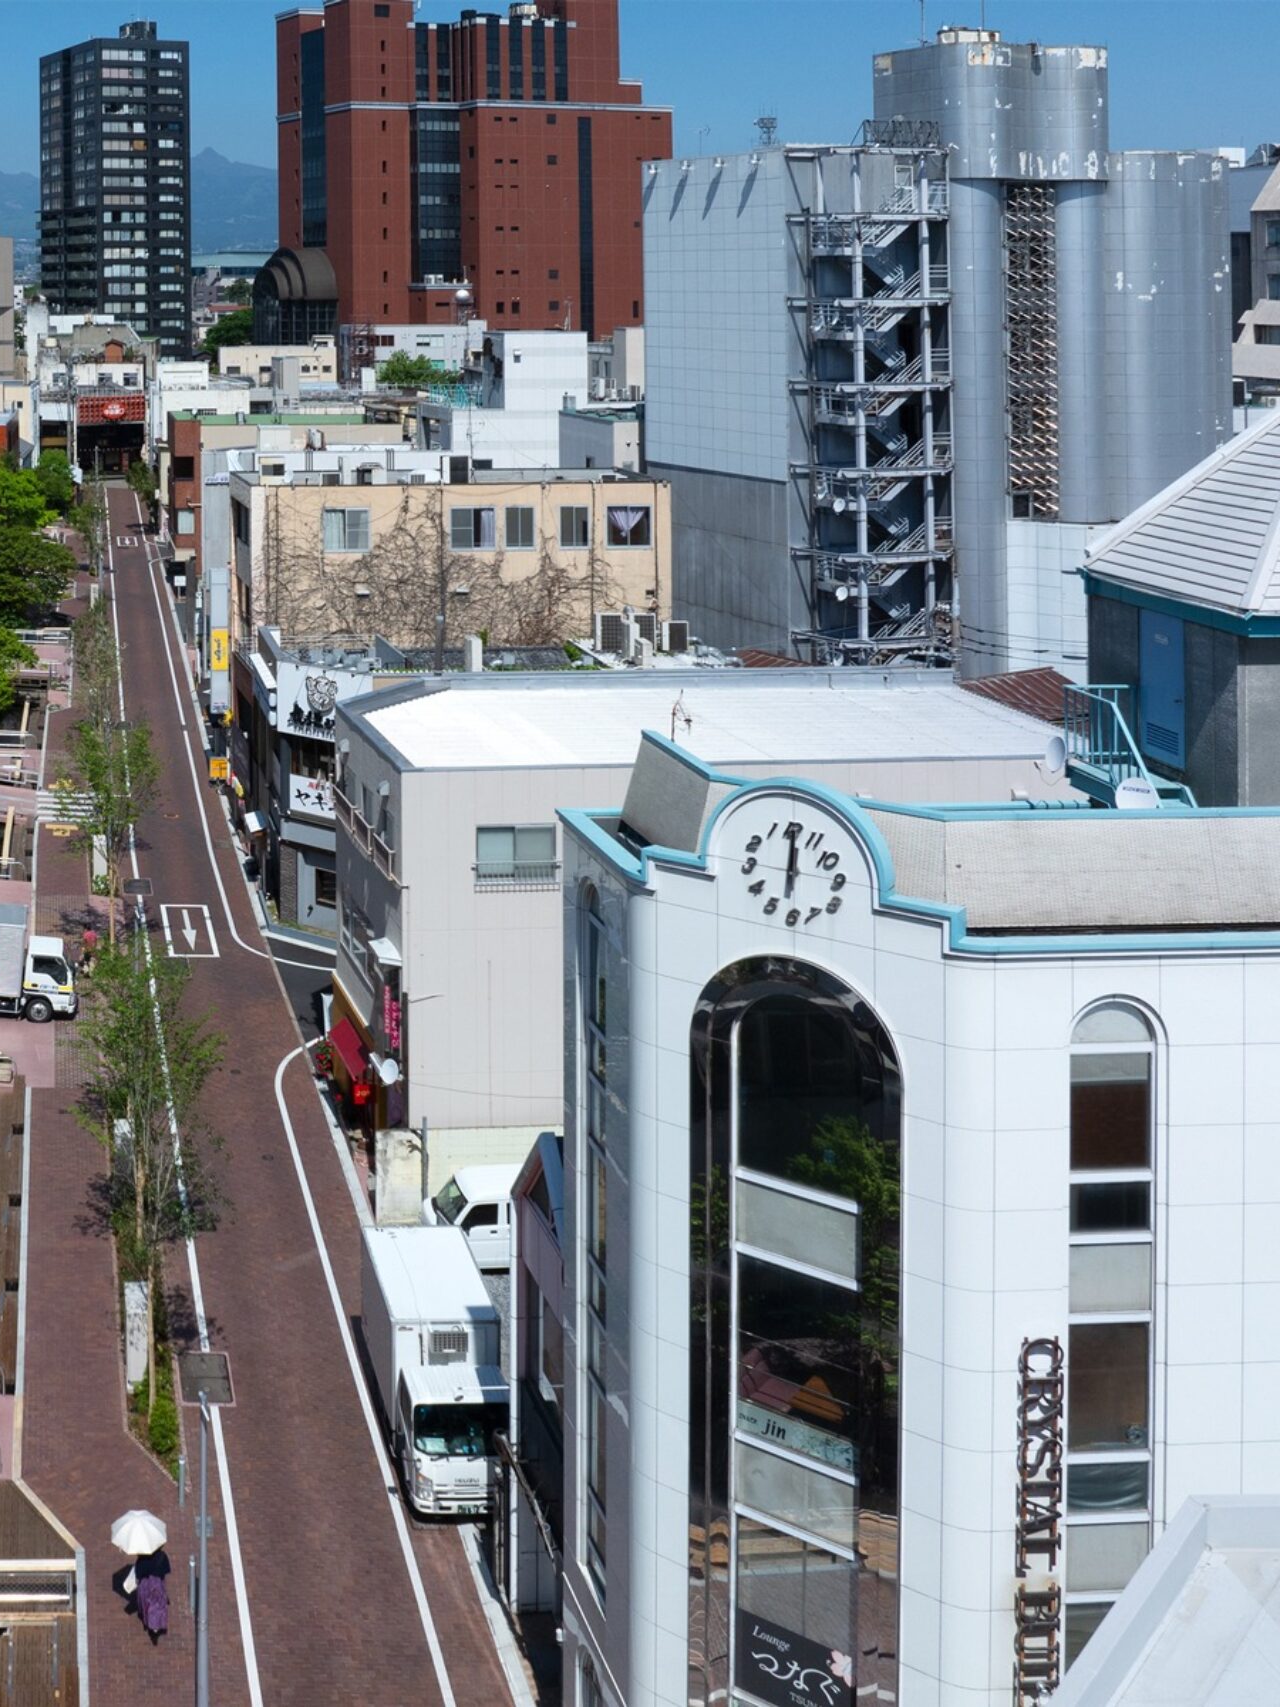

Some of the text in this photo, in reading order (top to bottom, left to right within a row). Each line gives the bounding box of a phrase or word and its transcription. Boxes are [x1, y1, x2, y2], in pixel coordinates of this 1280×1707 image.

[766, 822, 778, 840] 1
[745, 834, 763, 853] 2
[804, 831, 825, 851] 11
[741, 857, 758, 875] 3
[815, 851, 840, 871] 10
[747, 879, 766, 897] 4
[830, 872, 846, 892] 9
[763, 897, 780, 915] 5
[825, 895, 843, 915] 8
[785, 908, 801, 927] 6
[803, 906, 823, 925] 7
[761, 1418, 786, 1440] jin
[1015, 1337, 1064, 1577] CRYSTAL
[751, 1624, 791, 1652] Lounge
